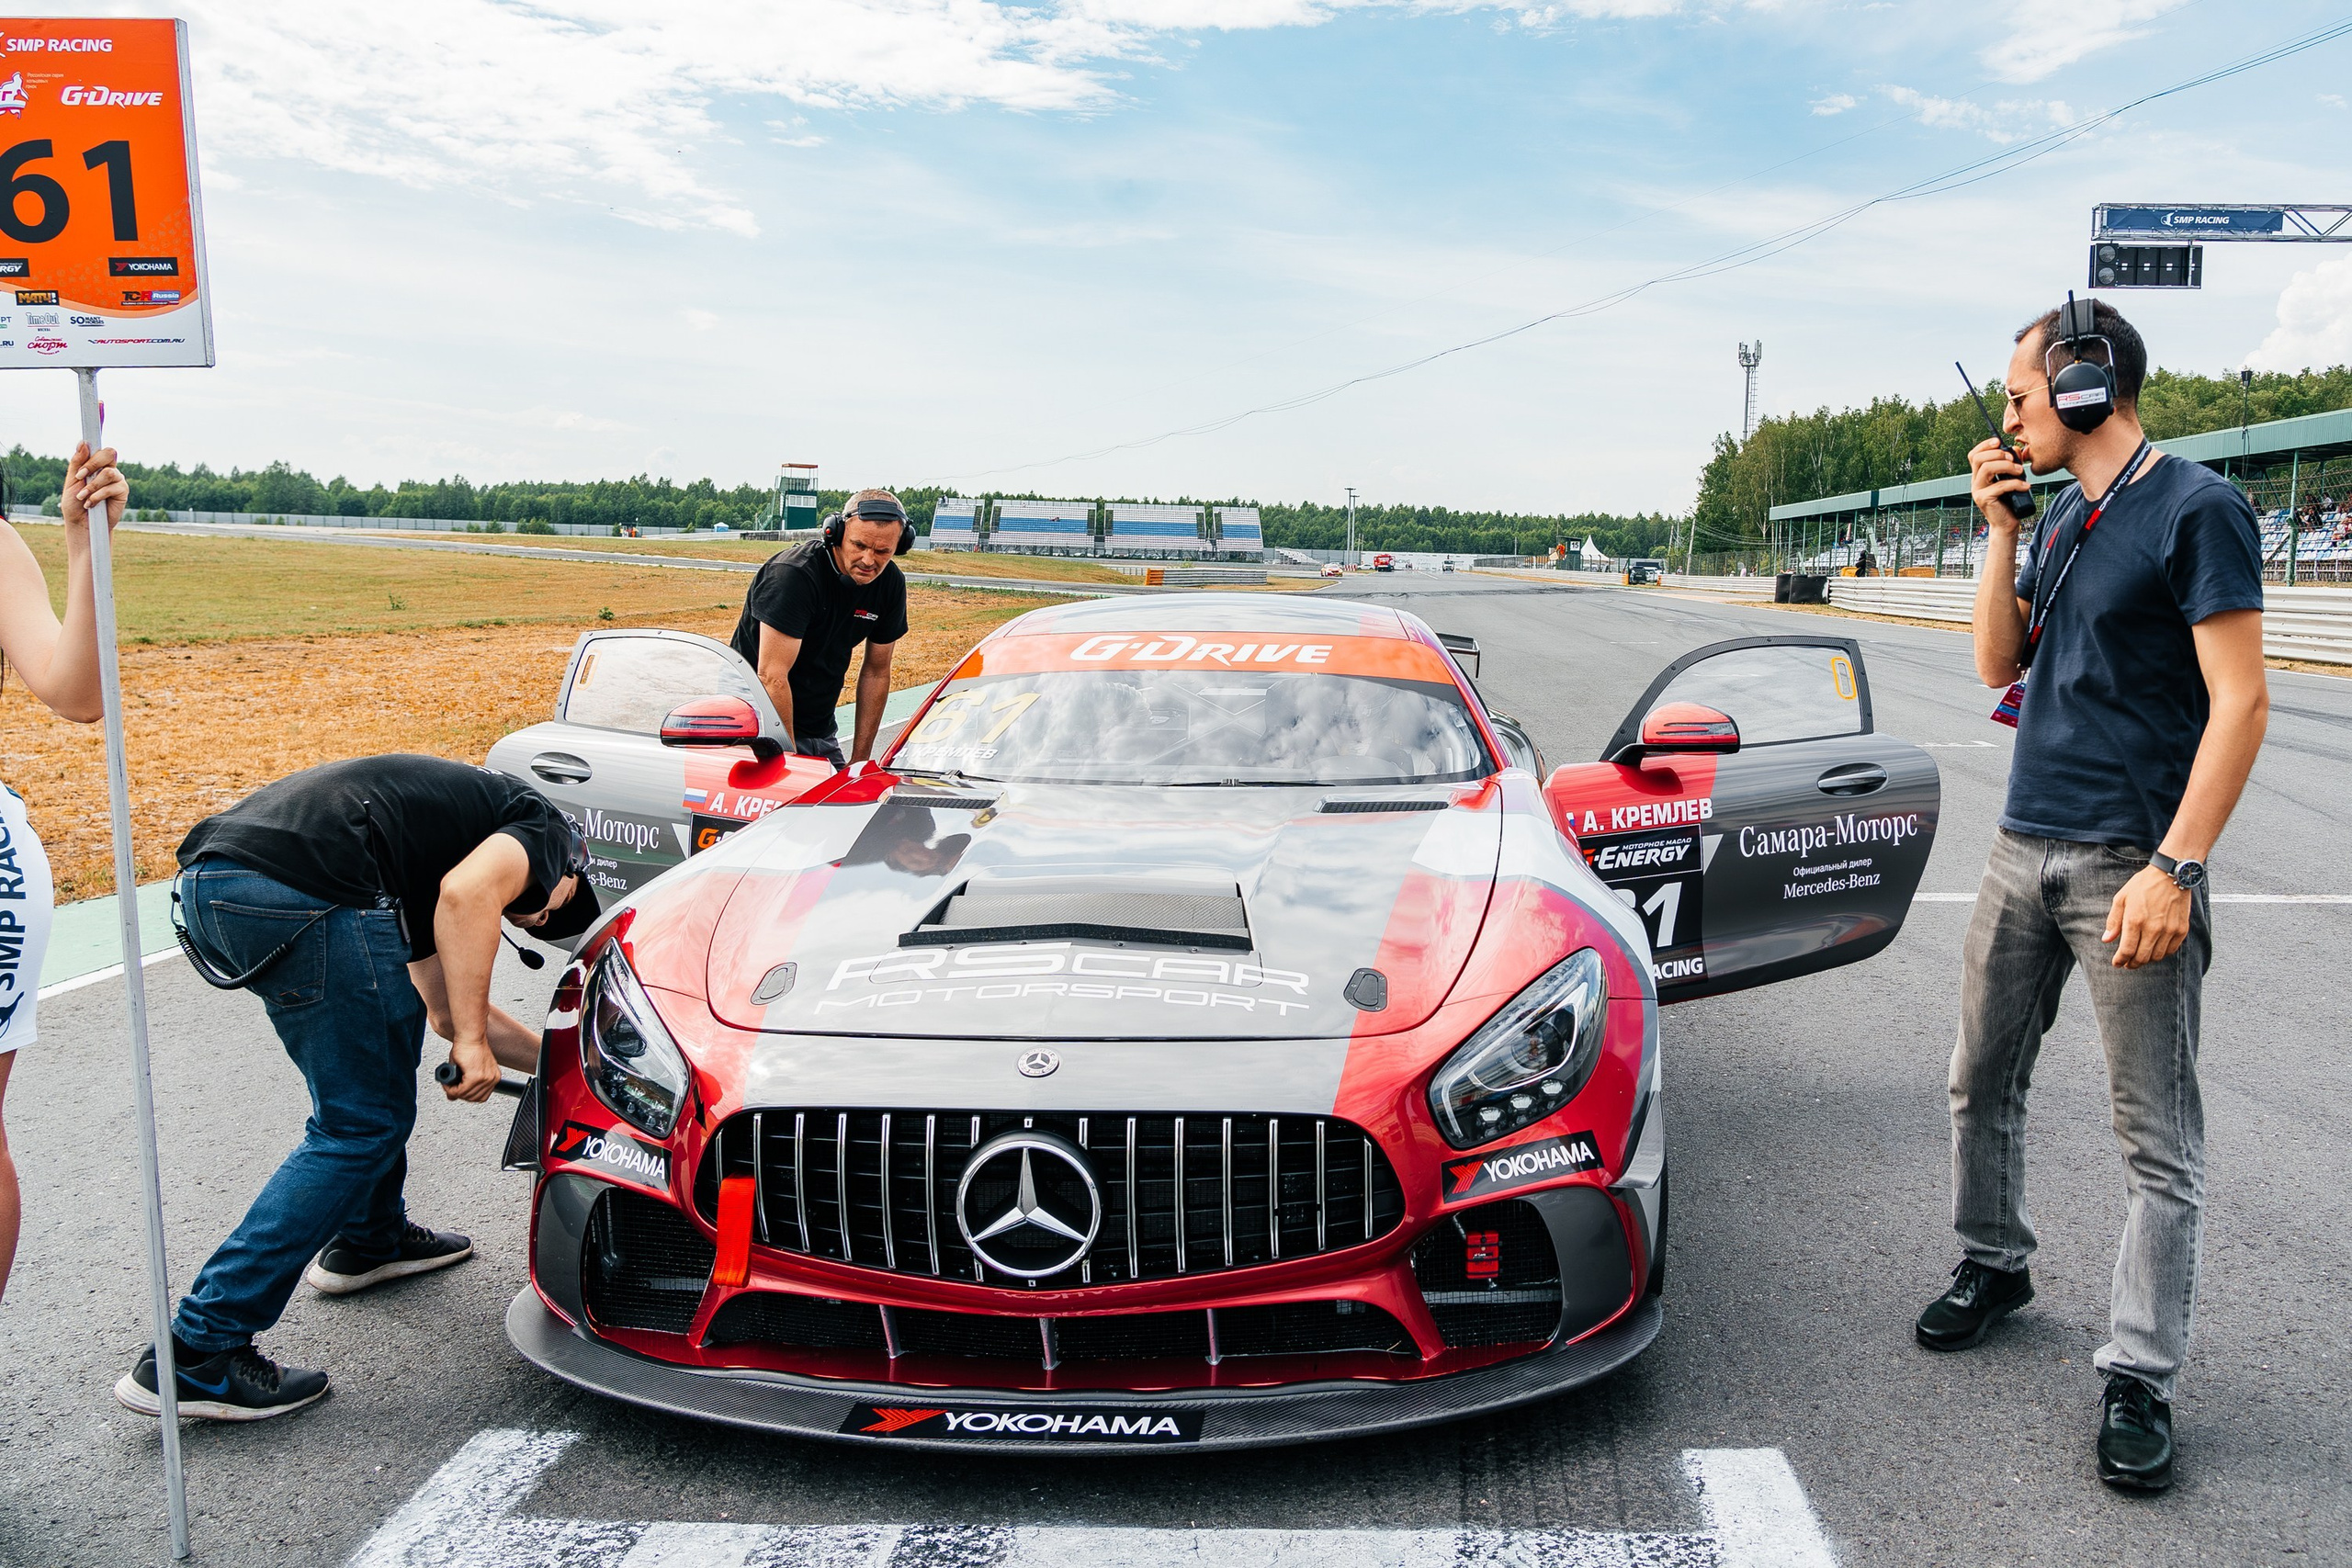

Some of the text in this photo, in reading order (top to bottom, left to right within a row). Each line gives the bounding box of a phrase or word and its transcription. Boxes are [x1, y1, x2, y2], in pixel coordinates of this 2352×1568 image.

[6, 39, 112, 52] SMP RACING
[0, 139, 139, 243] 61
[2174, 216, 2230, 225] SMP RACING
[128, 263, 173, 271] YOKOHAMA
[2113, 442, 2150, 491] MOTORSPO
[908, 690, 1042, 744] 61
[709, 792, 729, 814] А.
[1582, 797, 1713, 832] А. КРЕМЛЕВ
[1622, 837, 1692, 851] МОТОРНОЕ МАСЛО
[1739, 813, 1918, 858] Самара-Моторс
[596, 859, 617, 870] дилер
[1792, 858, 1872, 877] Официальный дилер
[1783, 873, 1881, 899] Mercedes-Benz
[825, 942, 1311, 996] RSCAR
[1654, 957, 1703, 980] ACING
[812, 981, 1311, 1017] MOTORSPORT
[582, 1135, 666, 1179] YOKOHAMA
[1483, 1141, 1595, 1183] YOKOHAMA
[944, 1412, 1181, 1436] YOKOHAMA
